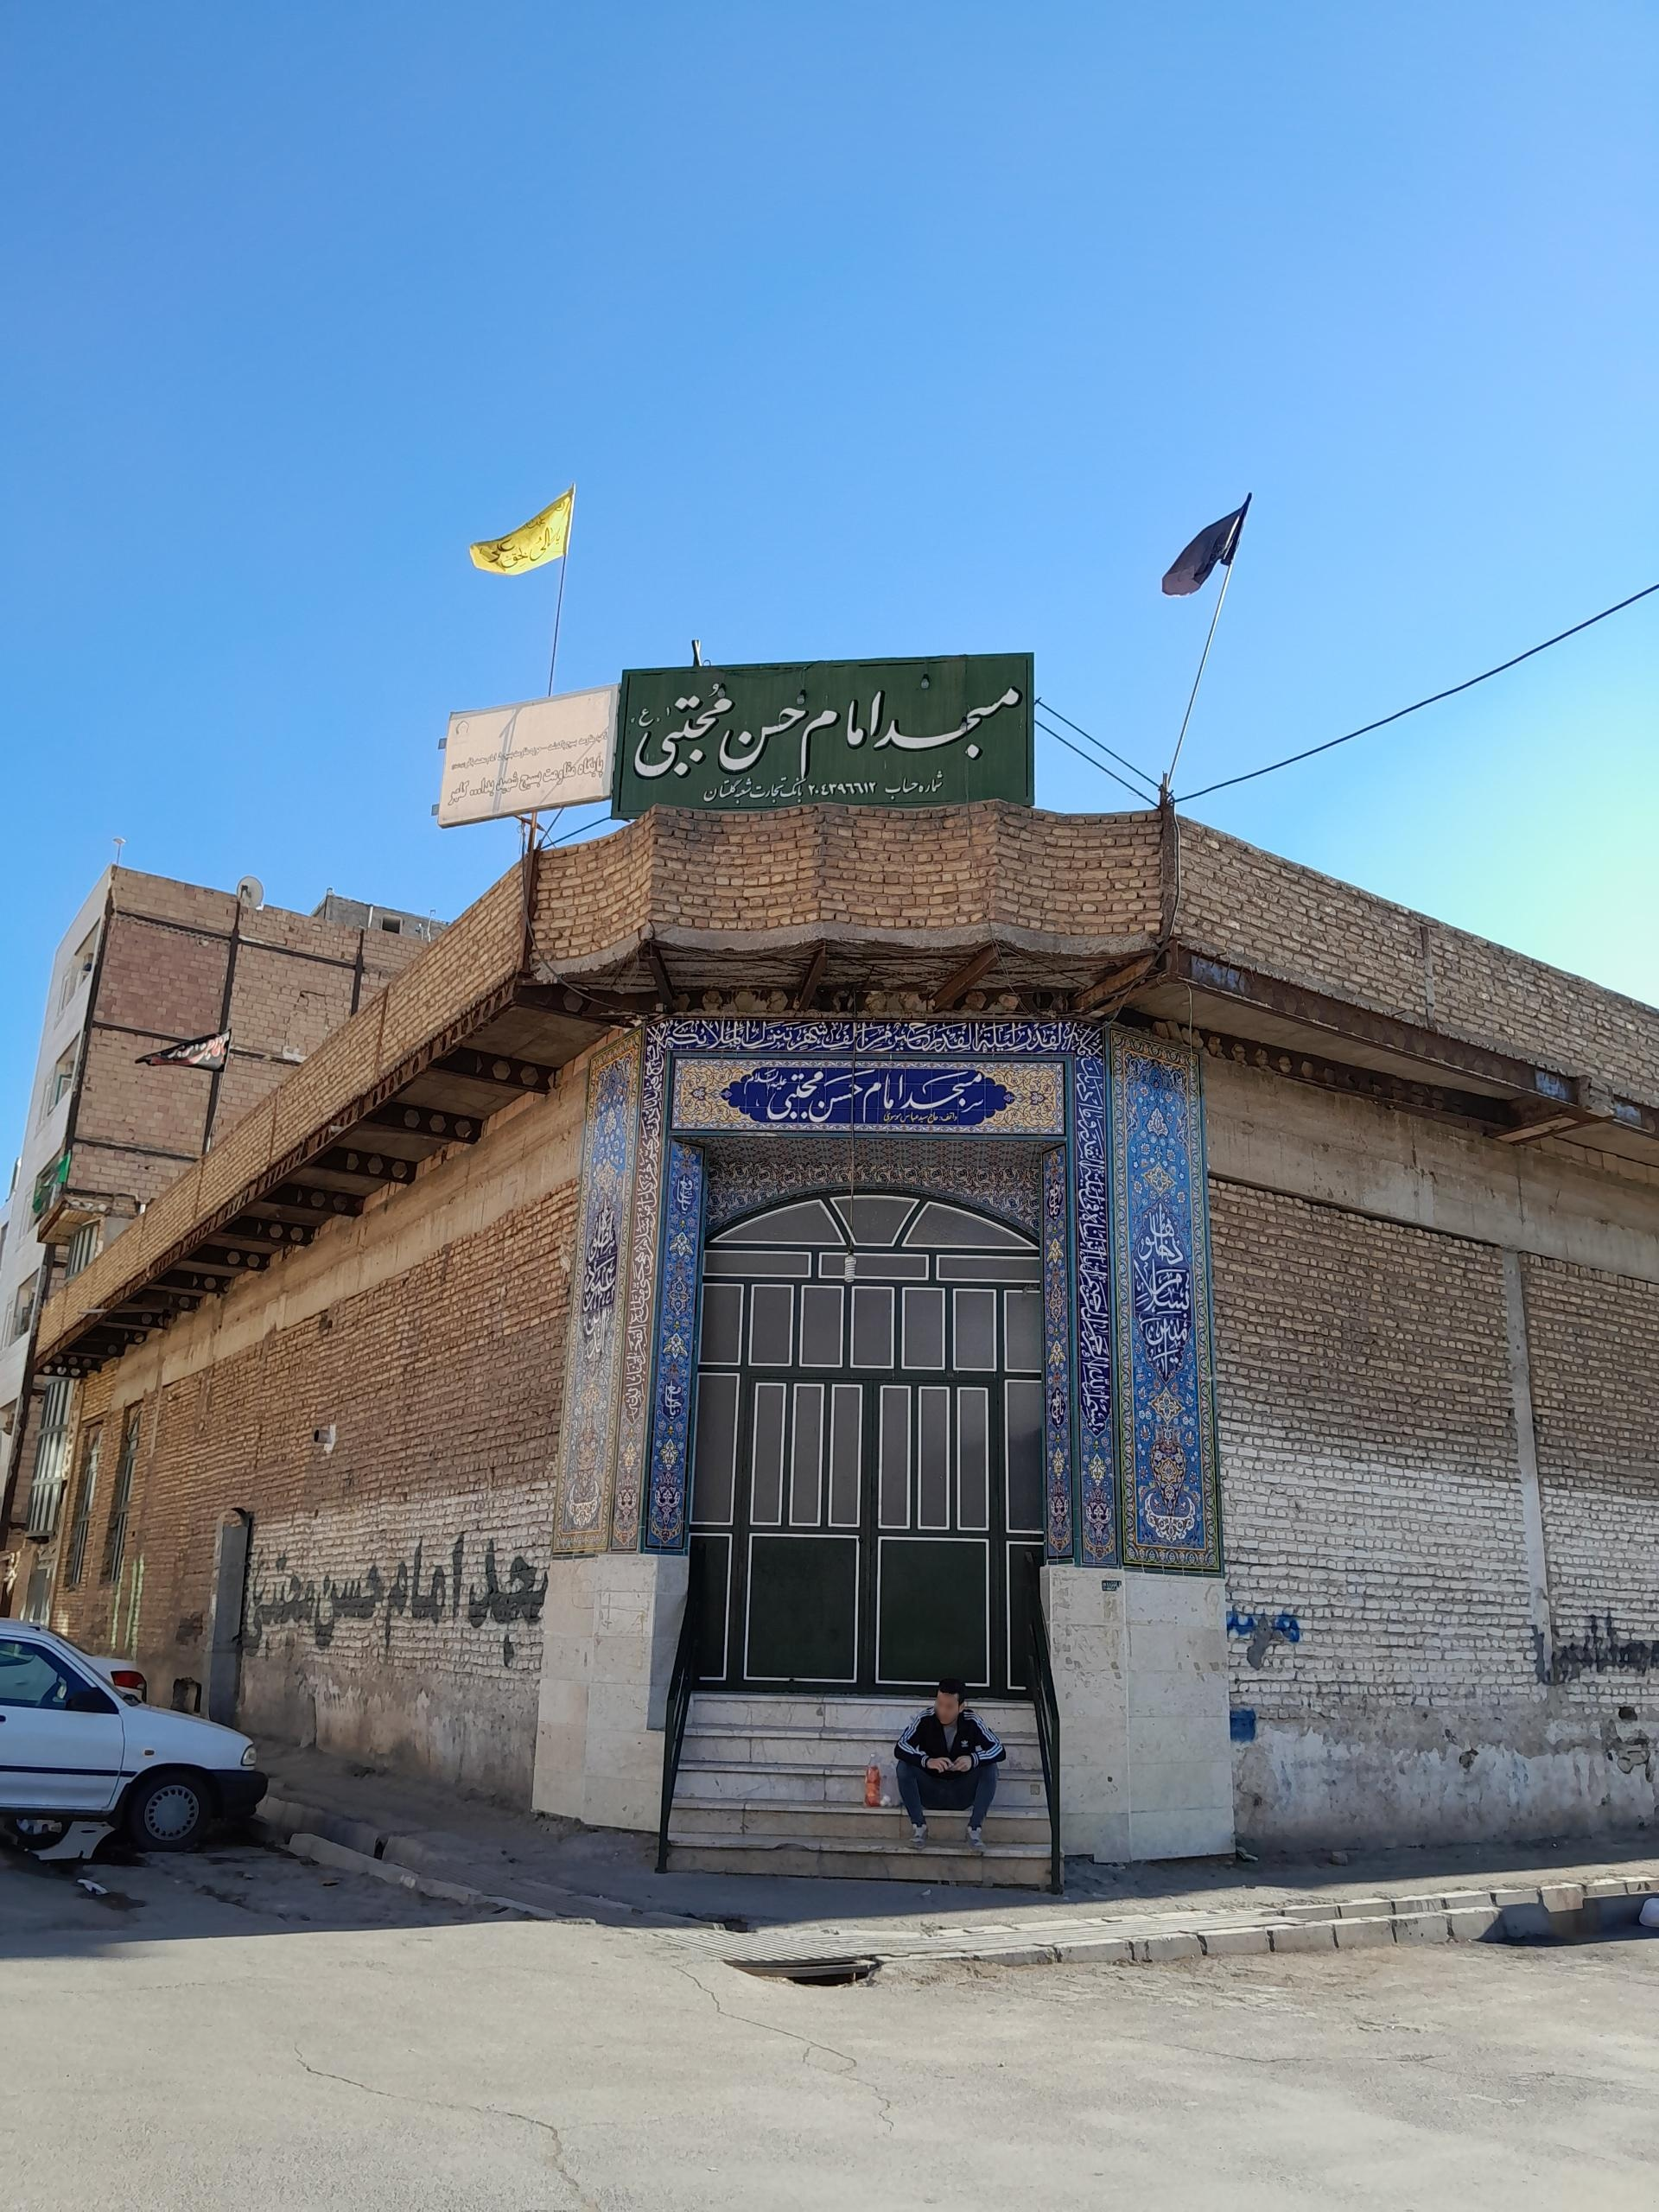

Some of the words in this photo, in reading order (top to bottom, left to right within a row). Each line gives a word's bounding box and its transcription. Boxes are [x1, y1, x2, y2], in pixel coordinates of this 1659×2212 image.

[800, 690, 882, 779] امام
[873, 687, 1020, 759] مسجد
[719, 707, 806, 771] حسن
[518, 771, 542, 791] بسیج
[543, 760, 577, 785] مقاومت
[918, 771, 944, 794] شماره
[703, 778, 743, 802] گلستان
[734, 777, 752, 804] شعبه
[749, 777, 787, 804] تجارت
[779, 778, 807, 804] بانک
[884, 777, 918, 800] حساب
[766, 1071, 824, 1120] مجتبی
[809, 1077, 864, 1123] حسن
[863, 1072, 904, 1123] امام
[901, 1071, 984, 1111] مسجد
